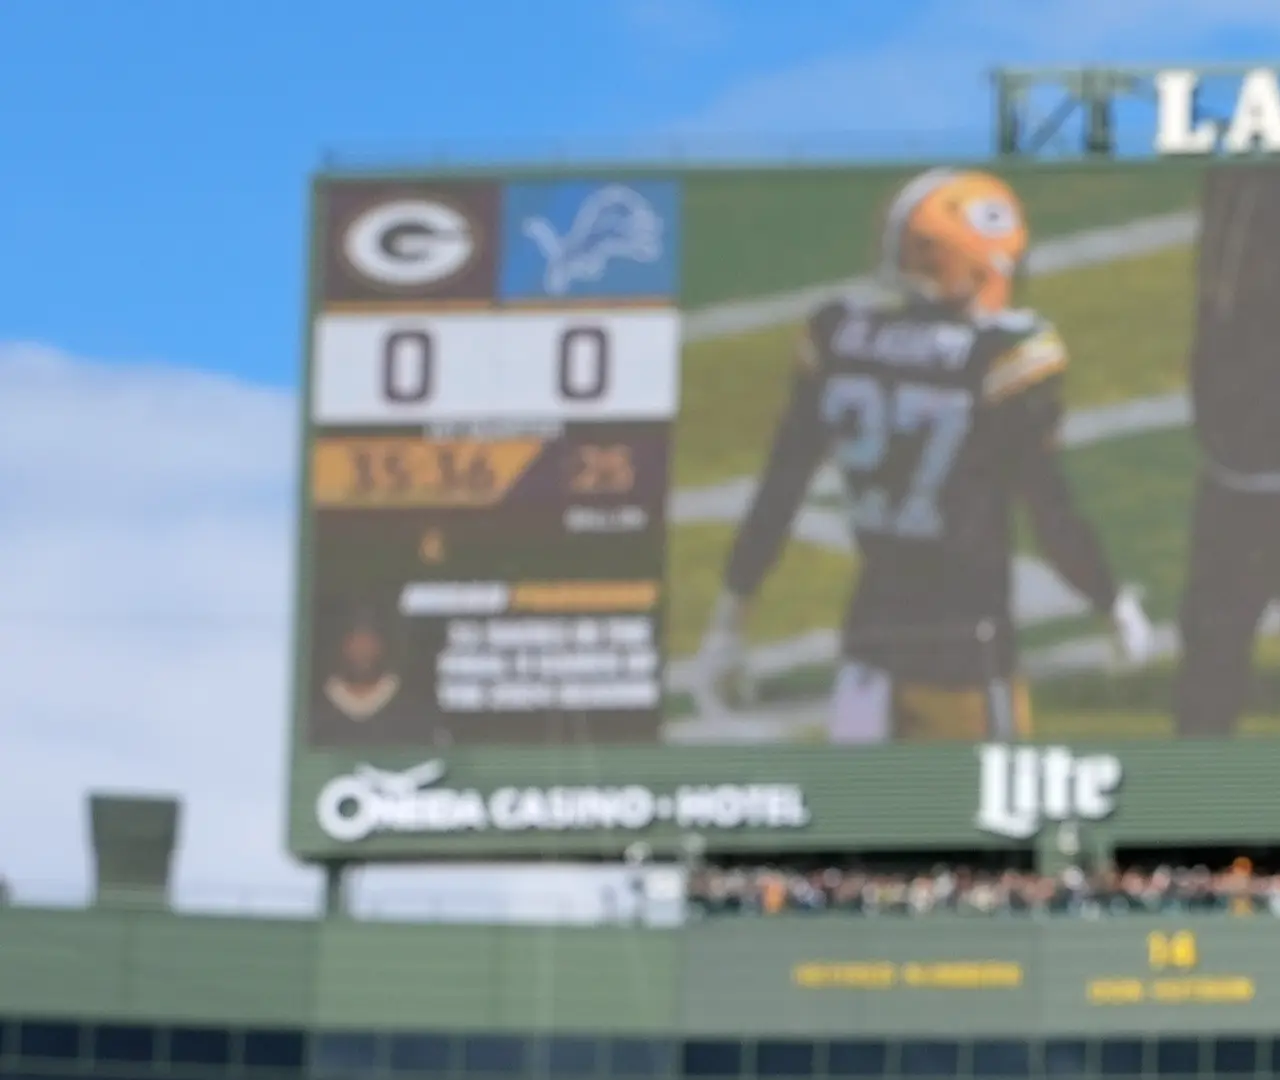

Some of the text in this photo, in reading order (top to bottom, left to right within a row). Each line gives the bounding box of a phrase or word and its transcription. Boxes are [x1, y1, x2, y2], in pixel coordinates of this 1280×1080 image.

[382, 327, 434, 404] 0
[558, 325, 608, 401] 0
[490, 787, 654, 828] CASINO
[677, 785, 808, 825] HOTEL
[977, 744, 1120, 837] Lite
[1148, 931, 1194, 968] 14
